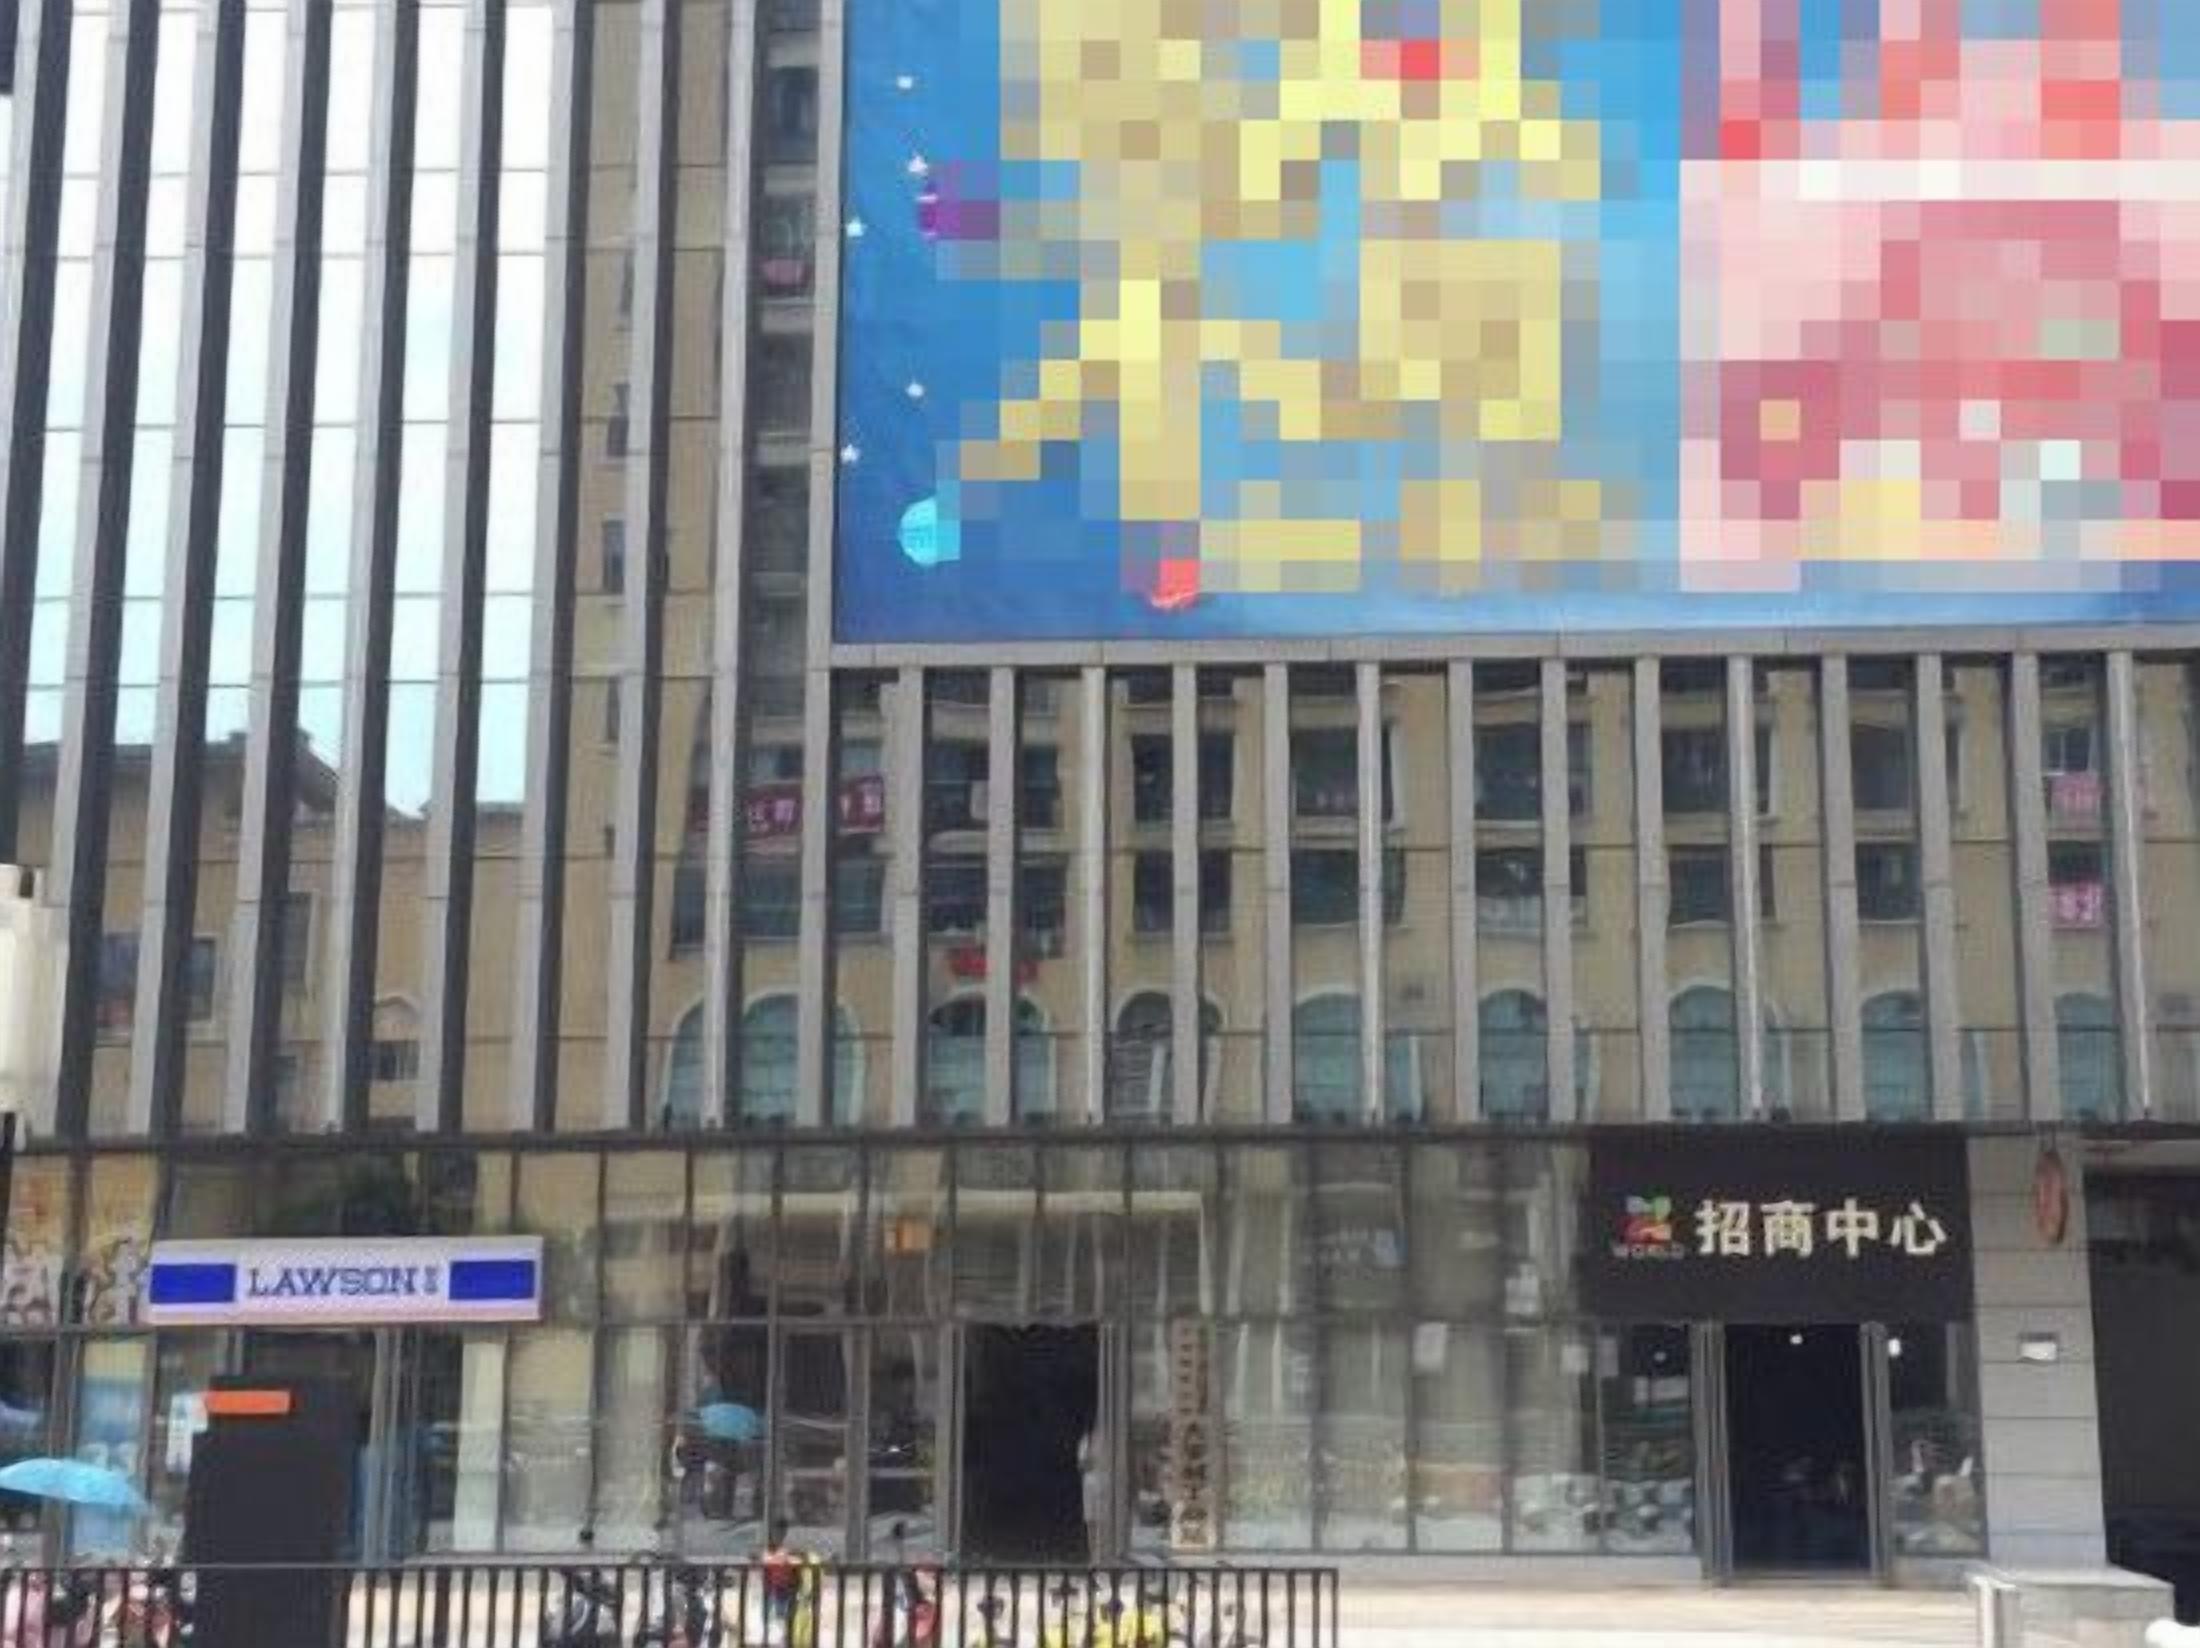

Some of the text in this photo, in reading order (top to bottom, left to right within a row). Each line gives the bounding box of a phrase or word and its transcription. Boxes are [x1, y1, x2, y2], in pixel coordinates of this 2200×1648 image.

[1694, 1198, 1946, 1258] 招商中心
[249, 1267, 416, 1296] LAWSON
